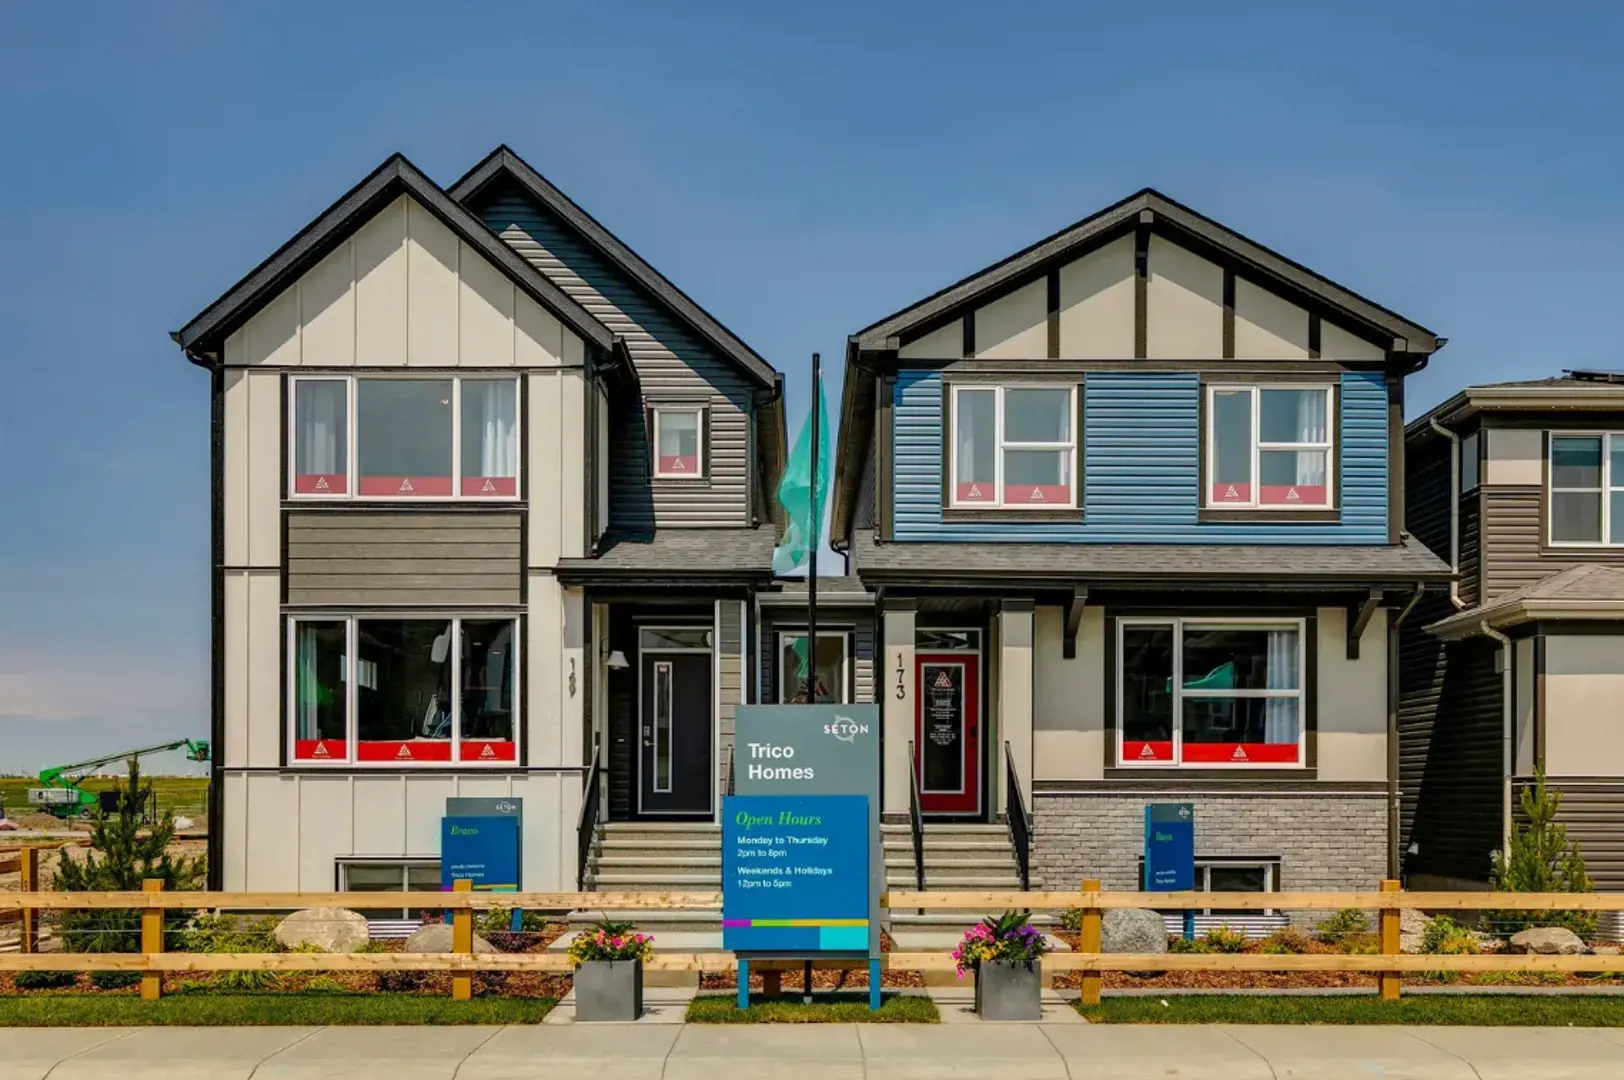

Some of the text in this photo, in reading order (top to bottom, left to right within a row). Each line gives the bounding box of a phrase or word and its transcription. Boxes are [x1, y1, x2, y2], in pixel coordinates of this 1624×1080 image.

[896, 652, 905, 700] 173
[823, 724, 869, 734] SETON
[747, 743, 795, 759] Trico
[748, 764, 815, 780] Homes
[735, 811, 822, 830] Open Hours
[737, 836, 828, 846] Monday to Thursday
[737, 849, 756, 858] 2pm
[758, 849, 767, 857] to
[737, 866, 833, 876] Weekends & Holidays
[738, 879, 761, 888] 12pm
[762, 879, 771, 888] to
